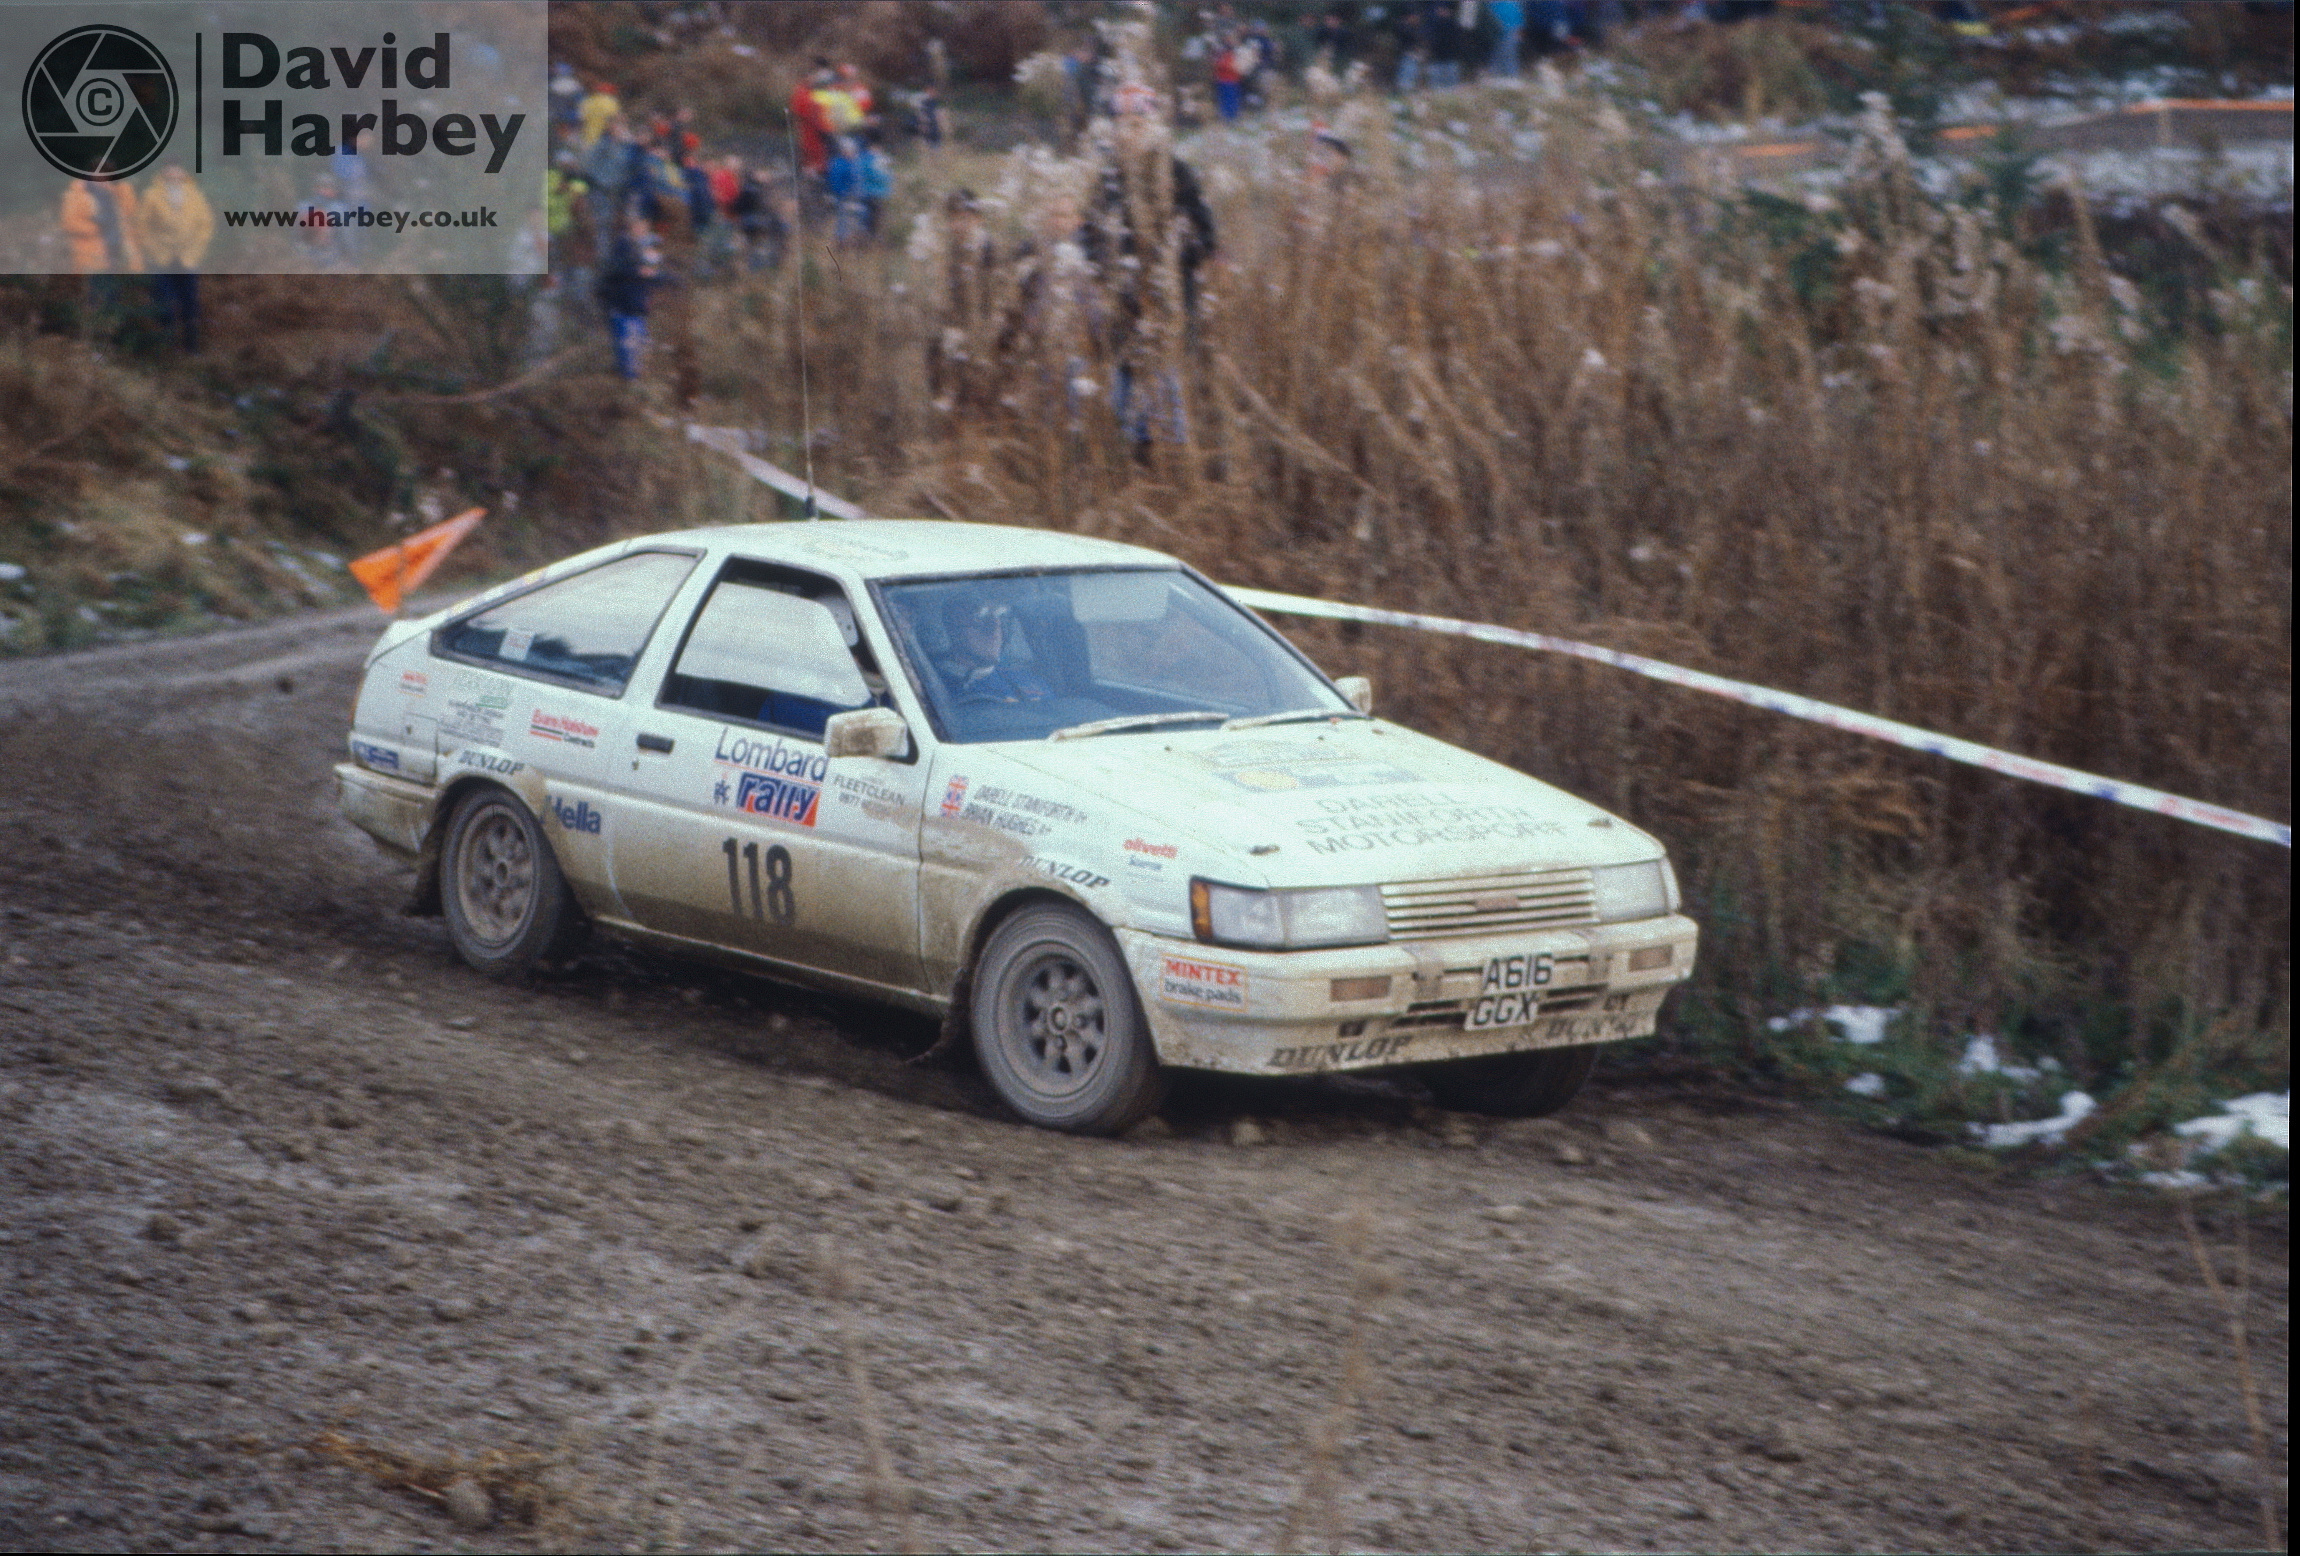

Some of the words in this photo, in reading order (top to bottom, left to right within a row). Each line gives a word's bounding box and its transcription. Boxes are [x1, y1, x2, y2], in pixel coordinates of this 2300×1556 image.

[458, 750, 525, 775] DUNLOP
[715, 726, 828, 782] Lombard
[738, 776, 820, 822] rally
[833, 774, 905, 806] FLEETCLEAN
[723, 837, 797, 925] 118
[1019, 854, 1110, 888] DUNLOP
[1164, 959, 1241, 986] MINTEX
[1483, 953, 1554, 989] A616
[1164, 980, 1203, 998] brake
[1205, 986, 1242, 1003] pads
[1473, 994, 1538, 1026] GGX
[1266, 1034, 1414, 1068] DUNLOP
